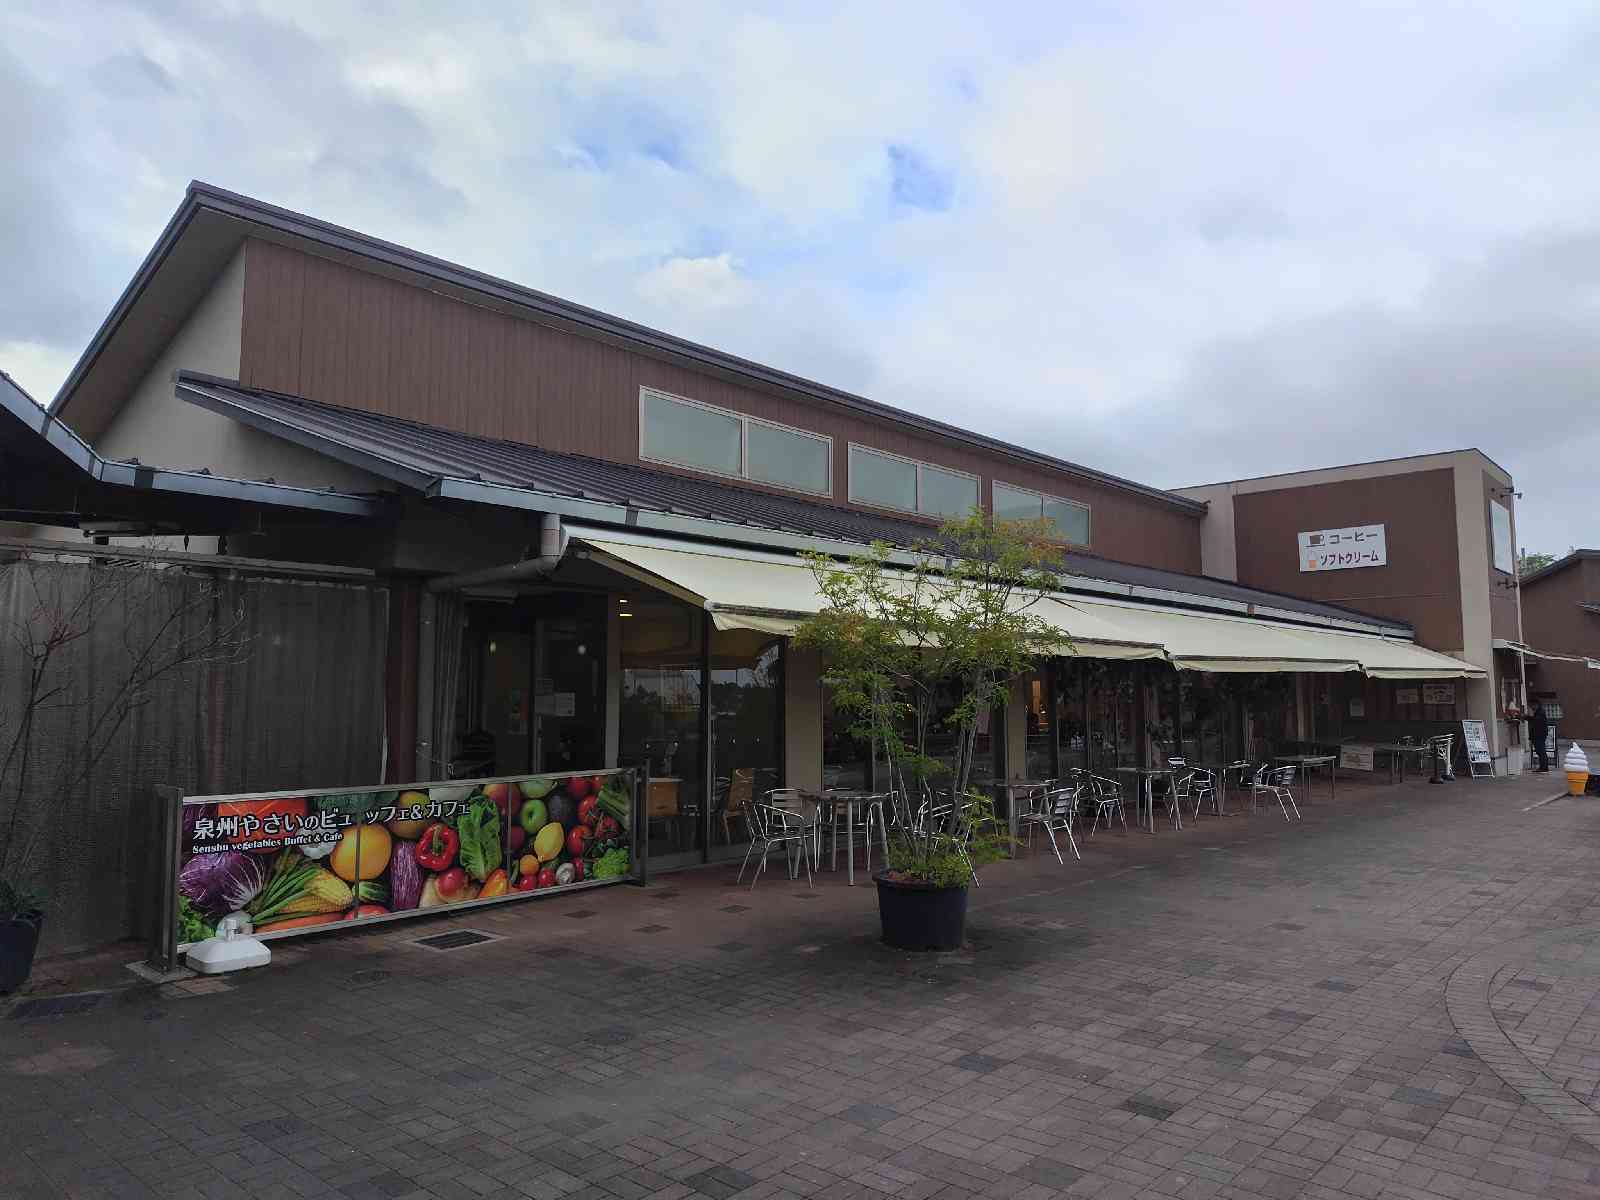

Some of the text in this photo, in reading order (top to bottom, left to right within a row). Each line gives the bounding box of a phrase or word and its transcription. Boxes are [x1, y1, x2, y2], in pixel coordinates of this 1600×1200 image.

[1328, 531, 1378, 545] コーヒー
[1320, 550, 1379, 566] ソフトクリーム
[192, 842, 229, 854] Senshu
[231, 839, 281, 851] vegetables
[284, 835, 312, 847] Buffet
[314, 834, 321, 843] &
